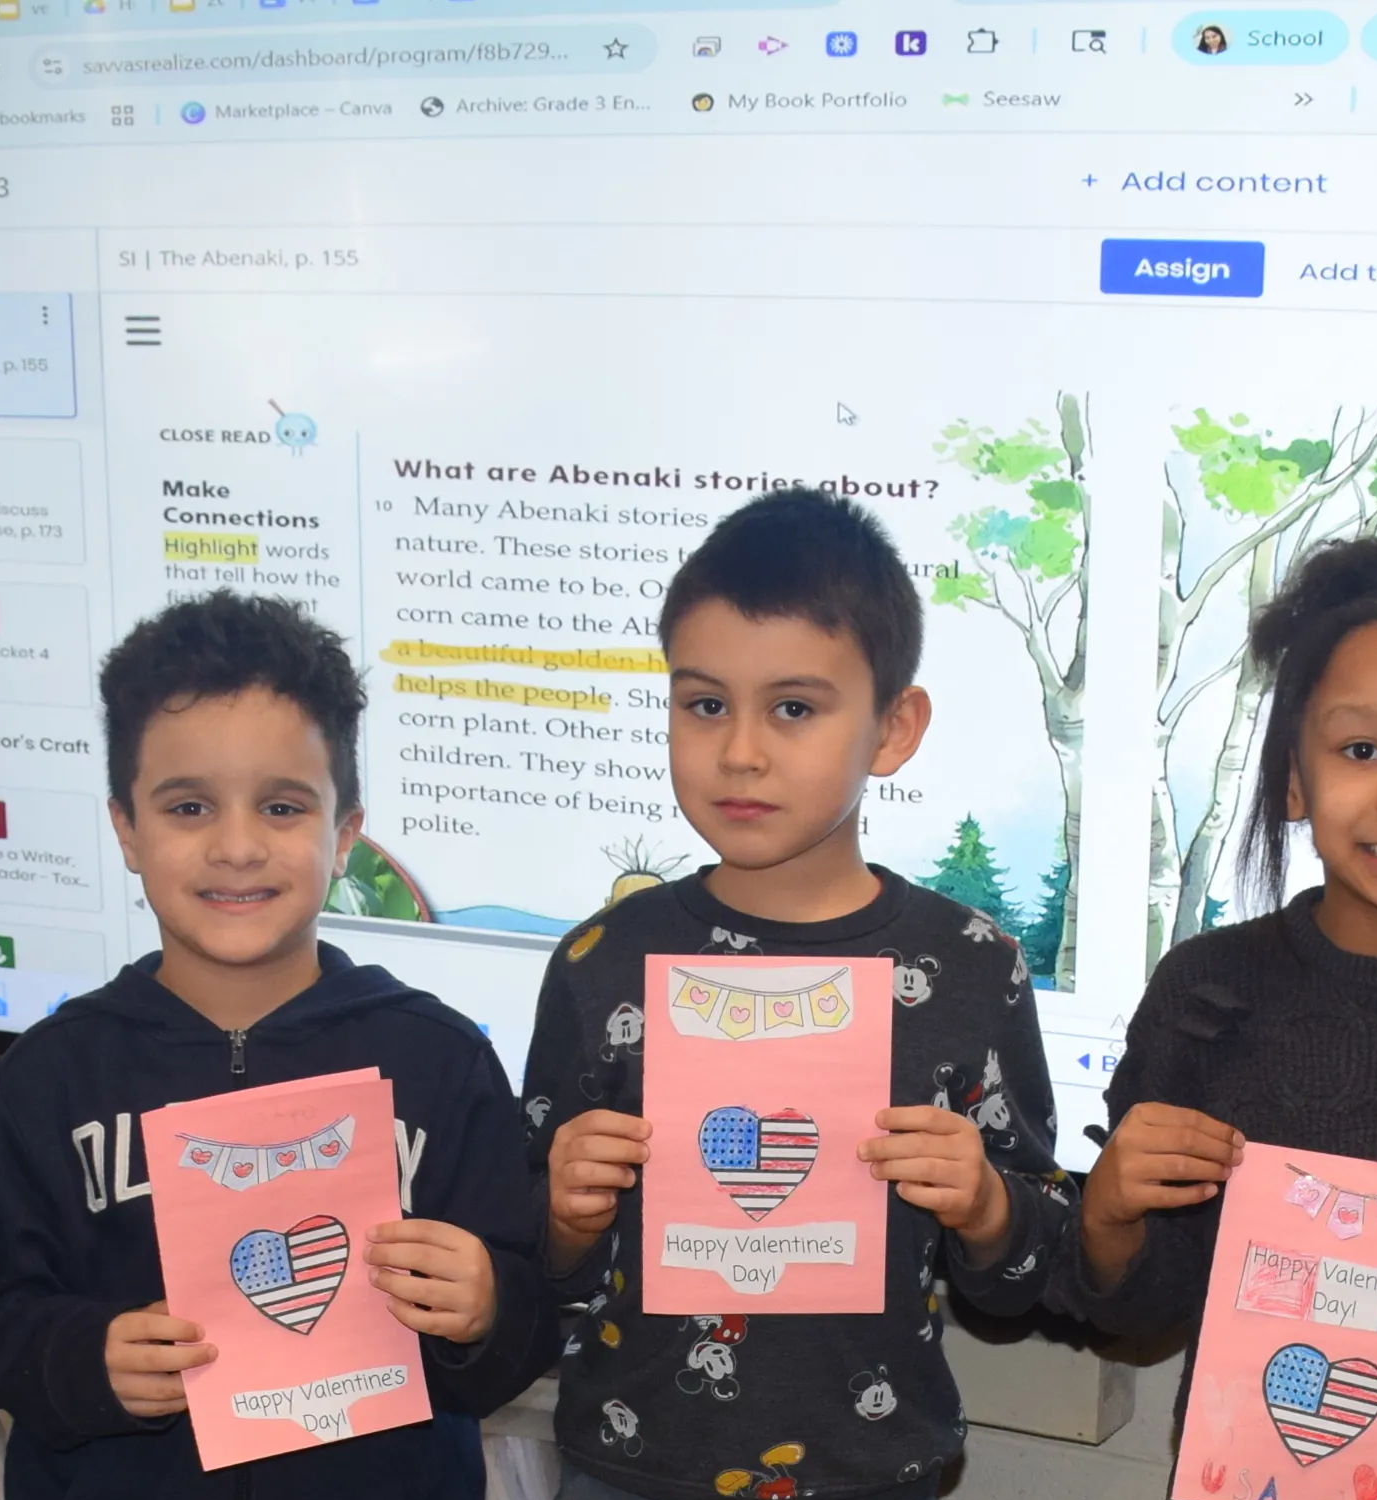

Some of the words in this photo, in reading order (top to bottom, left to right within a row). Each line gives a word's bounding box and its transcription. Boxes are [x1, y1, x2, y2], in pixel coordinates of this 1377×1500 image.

[1247, 28, 1324, 47] School
[765, 92, 815, 109] Book
[821, 92, 908, 109] Portfolio
[983, 91, 1062, 108] Seesaw
[1121, 171, 1186, 193] Add
[1196, 173, 1328, 194] content
[160, 250, 197, 267] The
[322, 250, 359, 267] 155
[1134, 257, 1231, 284] Assign
[1300, 262, 1358, 282] Add
[159, 428, 214, 442] CLOSE
[222, 430, 272, 444] READ
[394, 459, 476, 481] What
[487, 466, 537, 483] are
[549, 464, 682, 489] Abenaki
[162, 480, 230, 499] Make
[163, 506, 320, 529] Connections
[414, 495, 489, 525] Many
[497, 499, 609, 523] Abenaki
[618, 503, 709, 528] stories
[164, 537, 259, 561] Highlight
[266, 542, 330, 561] words
[396, 535, 485, 555] nature.
[494, 536, 572, 559] These
[579, 543, 669, 565] stories
[165, 563, 206, 582] that
[215, 564, 245, 583] tell
[253, 567, 298, 586] how
[305, 570, 341, 588] the
[397, 569, 473, 589] world
[481, 575, 550, 595] came
[397, 606, 453, 626] corn
[461, 611, 529, 630] came
[572, 612, 613, 636] the
[419, 638, 534, 665] beautiful
[398, 673, 467, 700] helps
[475, 677, 514, 700] the
[399, 711, 455, 730] corn
[463, 714, 537, 737] plant.
[545, 717, 623, 742] Other
[39, 736, 90, 755] Craft
[400, 743, 511, 769] children.
[520, 751, 586, 781] They
[594, 758, 666, 781] show
[401, 776, 547, 807] importance
[588, 792, 662, 823] being
[402, 813, 480, 836] polite.
[666, 1235, 729, 1262] Happy
[735, 1234, 845, 1256] Valentine's
[1253, 1245, 1319, 1283] Happy
[732, 1264, 777, 1292] Day!
[1312, 1290, 1358, 1327] Day!
[233, 1388, 297, 1420] Happy
[299, 1366, 407, 1401] Valentine's
[302, 1407, 348, 1438] Day!
